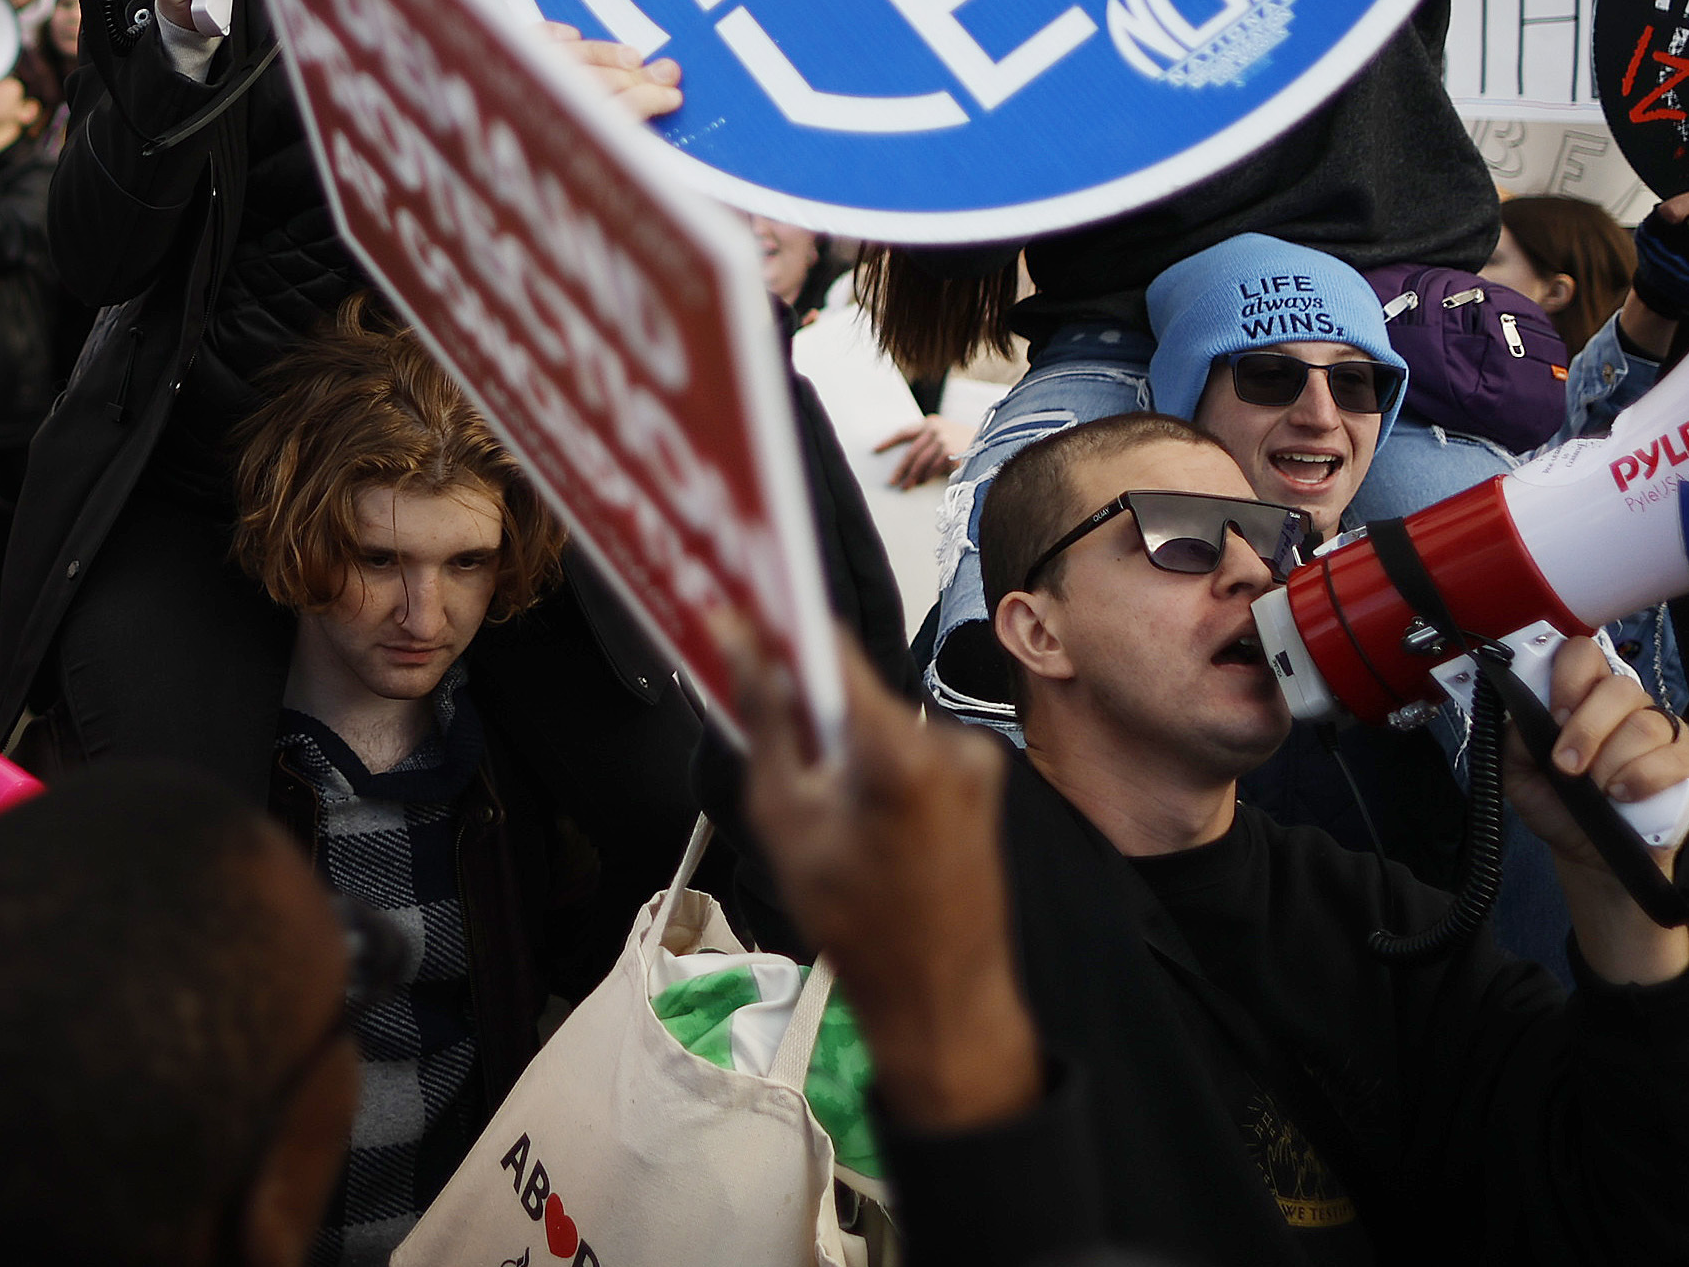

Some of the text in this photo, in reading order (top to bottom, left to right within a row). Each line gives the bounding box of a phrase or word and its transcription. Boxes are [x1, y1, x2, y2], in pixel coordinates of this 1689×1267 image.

[1240, 276, 1314, 300] LIFE
[1242, 296, 1323, 318] always
[1093, 506, 1111, 523] QUAY
